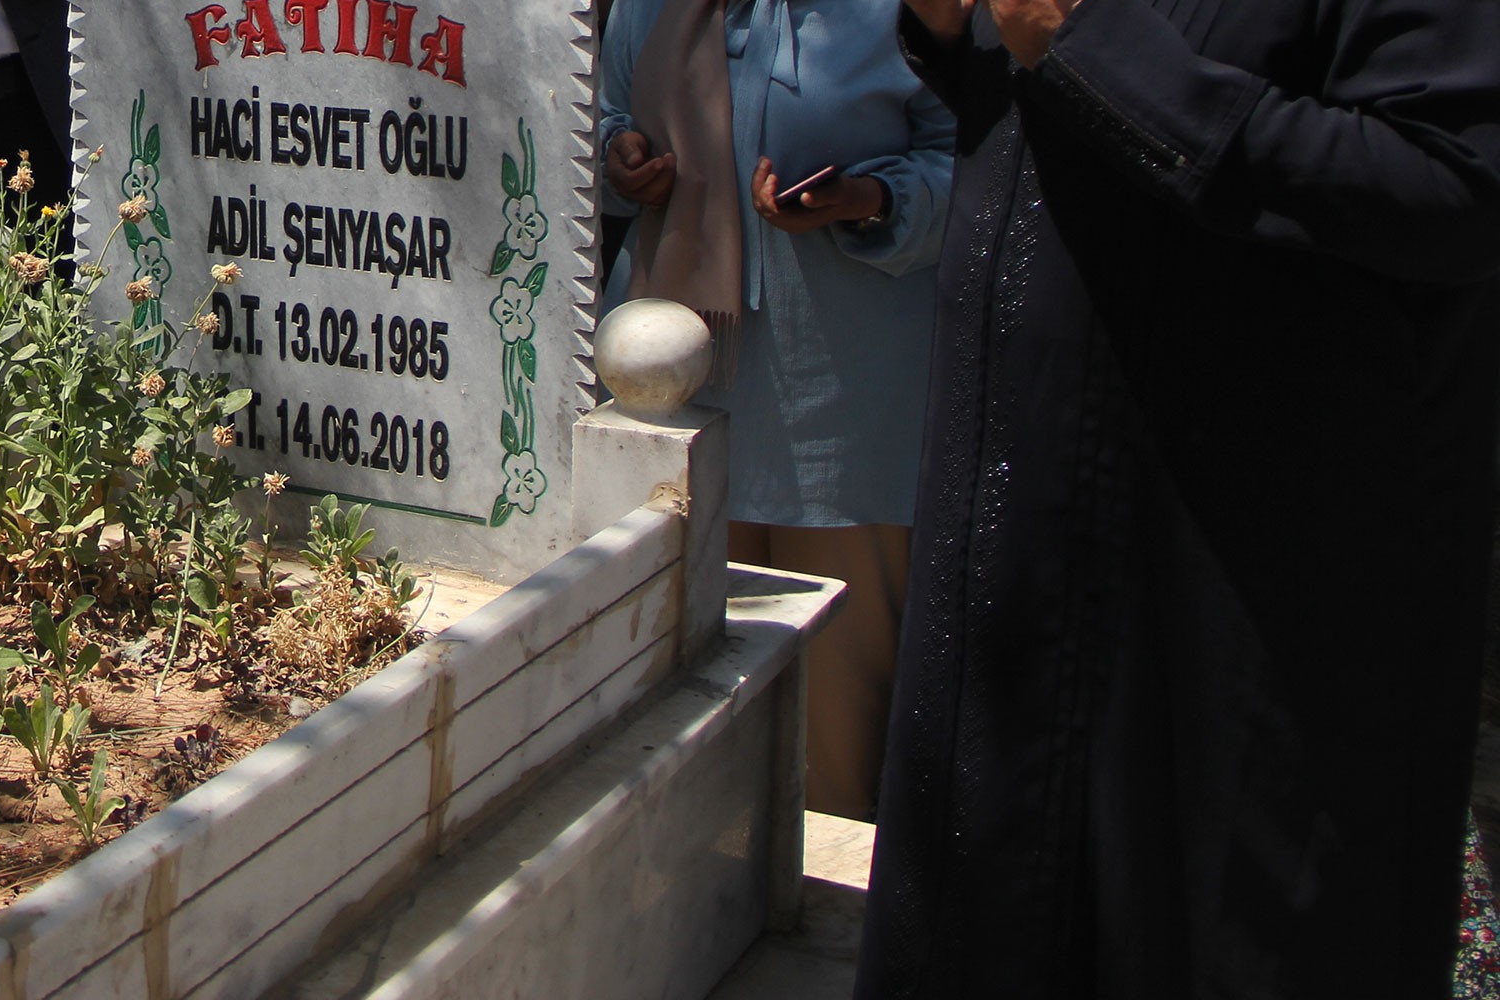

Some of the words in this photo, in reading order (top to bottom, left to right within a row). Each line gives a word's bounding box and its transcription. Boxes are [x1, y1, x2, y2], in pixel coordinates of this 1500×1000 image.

[190, 85, 260, 162] HACİ
[271, 103, 370, 170] ESVET
[379, 97, 467, 180] OĞLU
[207, 184, 276, 261] ADİL
[283, 202, 451, 289] ŞENYAŞAR
[211, 292, 263, 355] D.T.
[275, 301, 449, 381] 13.02.1985
[277, 398, 450, 481] 14.06.2018
